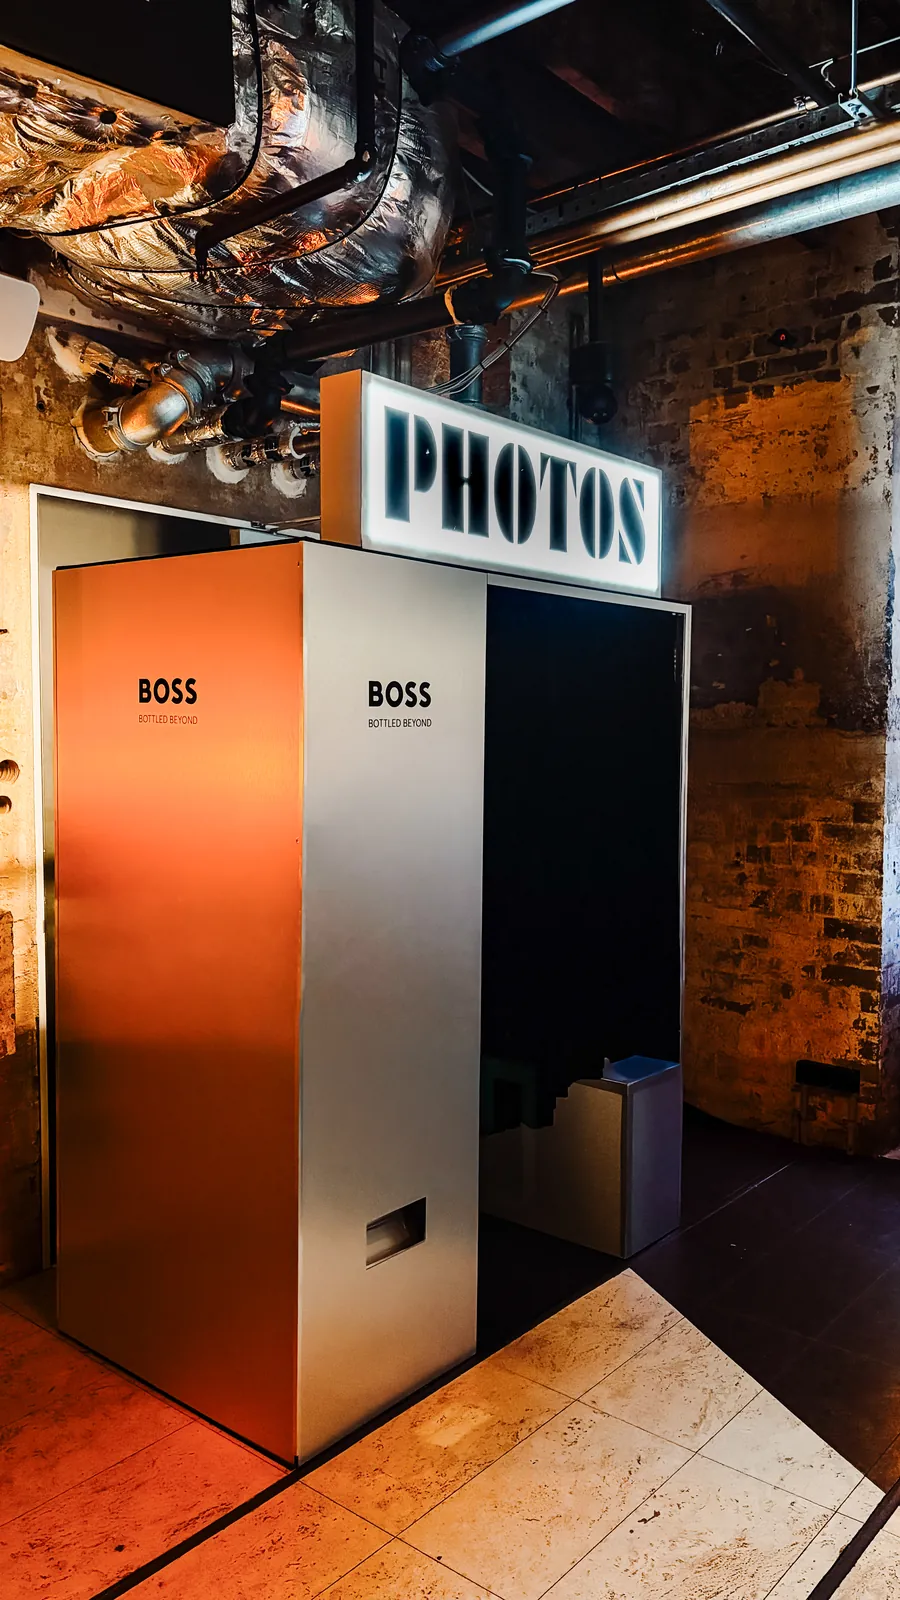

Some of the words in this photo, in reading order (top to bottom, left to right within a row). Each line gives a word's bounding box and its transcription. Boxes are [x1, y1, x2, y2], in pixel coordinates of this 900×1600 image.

[384, 405, 646, 566] PHOTOS
[138, 677, 198, 705] BOSS
[368, 680, 432, 708] BOSS
[138, 714, 168, 724] BOTTLED
[169, 715, 198, 725] BEYOND
[368, 718, 401, 728] BOTTLED
[402, 718, 432, 728] BEYOND
